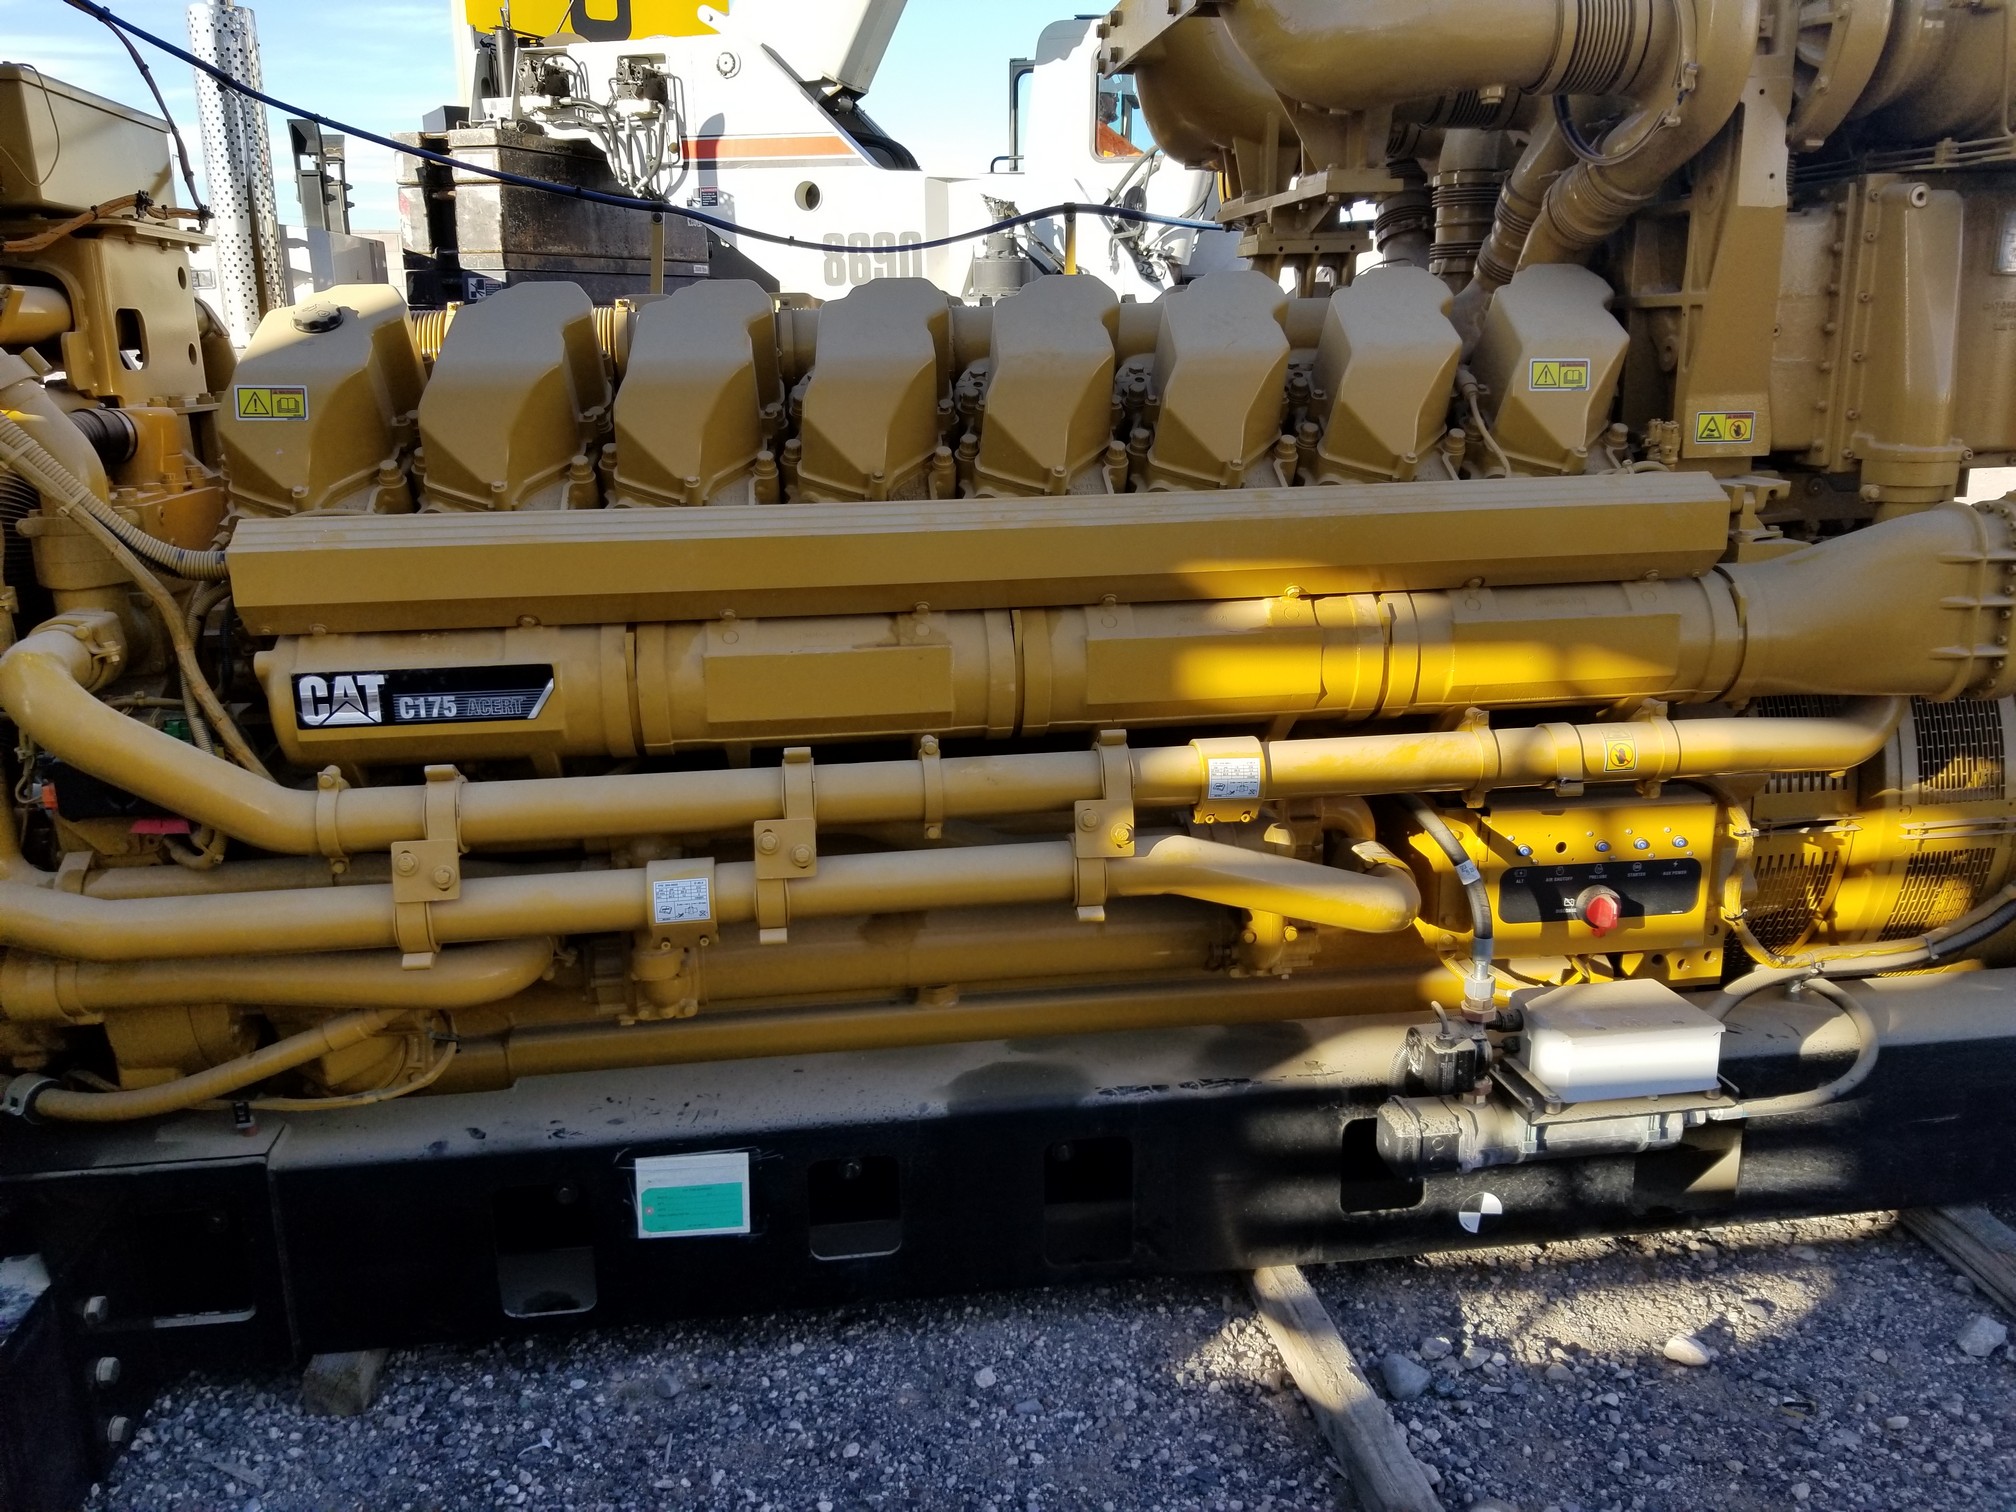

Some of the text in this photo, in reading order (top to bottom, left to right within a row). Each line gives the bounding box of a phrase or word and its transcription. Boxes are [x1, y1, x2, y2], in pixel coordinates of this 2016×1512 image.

[822, 231, 923, 286] 8690
[299, 674, 386, 726] CAT
[400, 696, 525, 719] C175 ACERT
